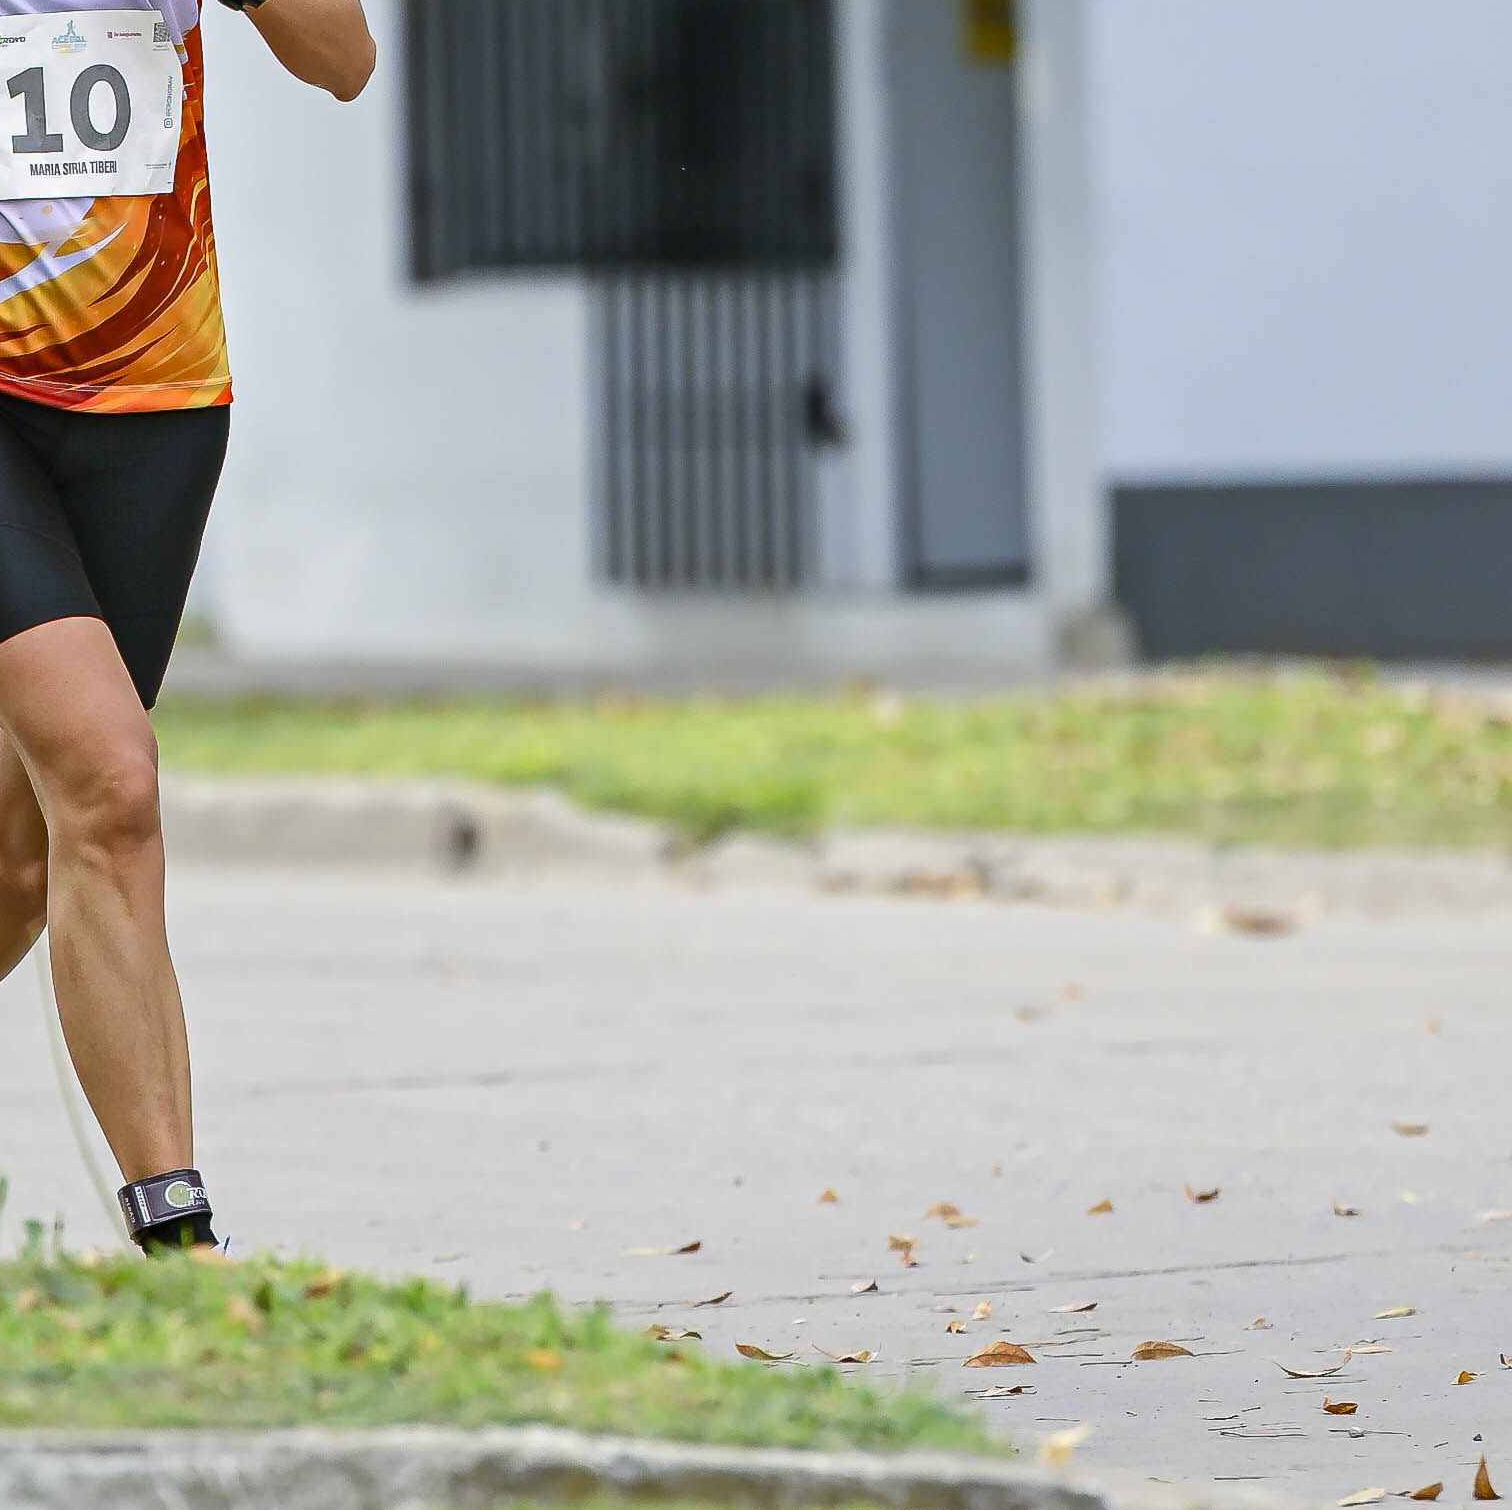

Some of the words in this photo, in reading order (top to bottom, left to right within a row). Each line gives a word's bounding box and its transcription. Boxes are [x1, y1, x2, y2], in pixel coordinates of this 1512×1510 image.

[6, 64, 131, 153] 10
[30, 163, 61, 177] MARIA
[62, 162, 88, 175] SIRIA
[89, 160, 118, 174] TIBERI
